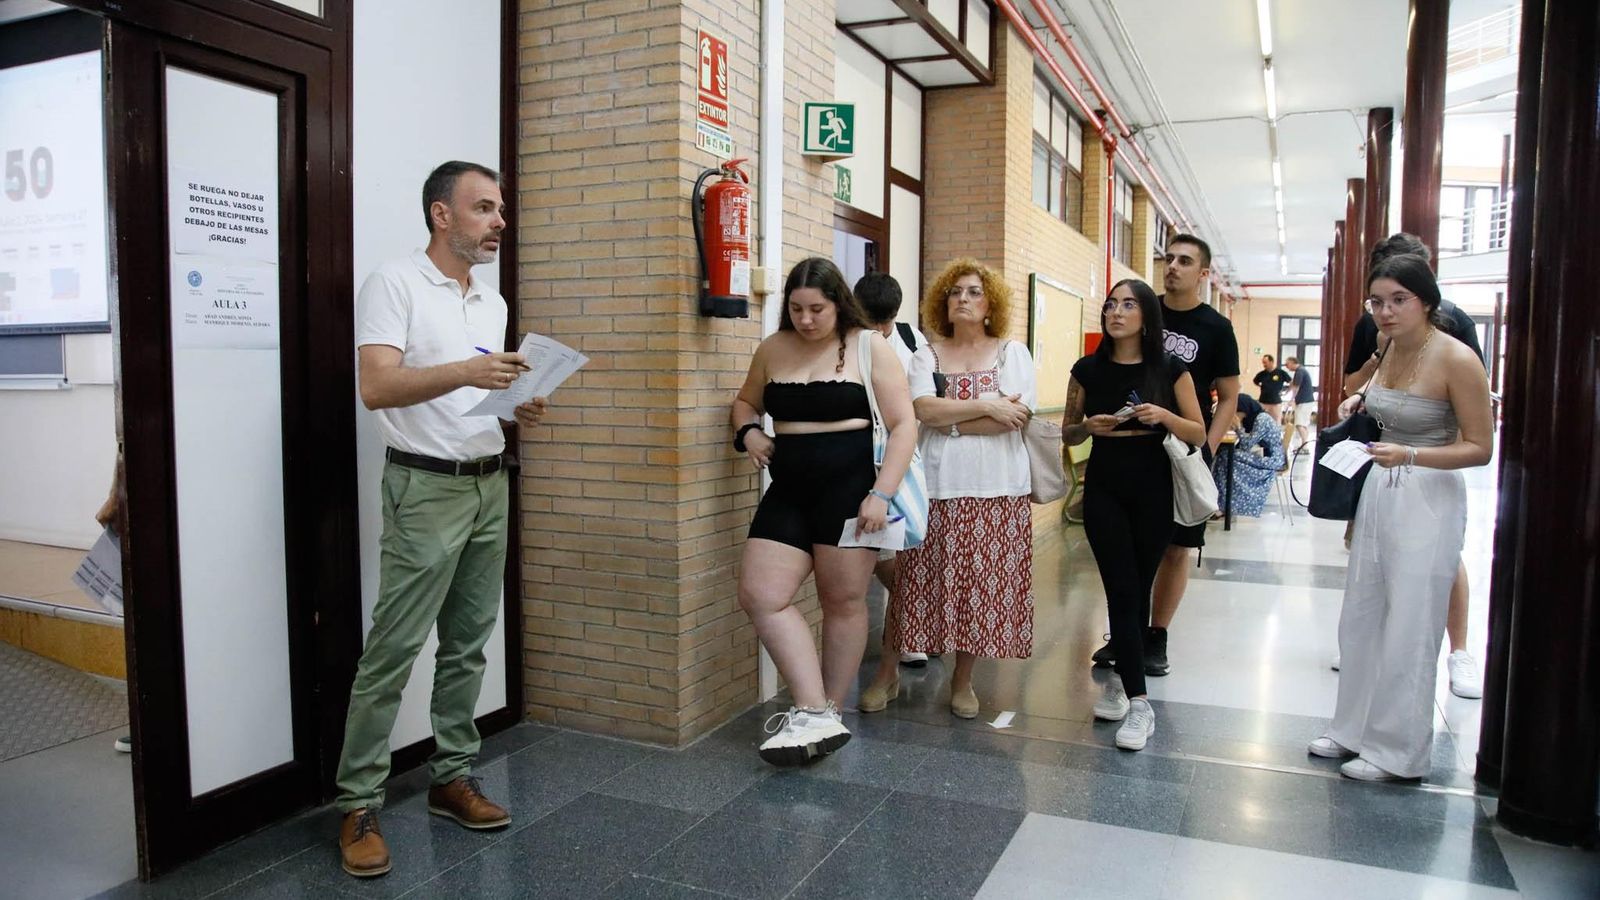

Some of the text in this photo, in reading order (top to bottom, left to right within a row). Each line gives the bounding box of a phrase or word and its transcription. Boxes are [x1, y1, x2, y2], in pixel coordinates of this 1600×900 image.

[699, 100, 727, 123] EXTINTOR
[188, 182, 265, 202] SE RUEGA NO DEJAR
[189, 195, 231, 208] BOTELLAS,
[232, 202, 257, 211] VASOS
[189, 206, 265, 223] OTROS RECIPIENTES
[184, 217, 216, 228] DEBAJO
[229, 224, 243, 232] LAS
[244, 226, 269, 235] MESAS
[208, 234, 247, 245] ¡GRACIAS!
[212, 299, 247, 310] AULA 3
